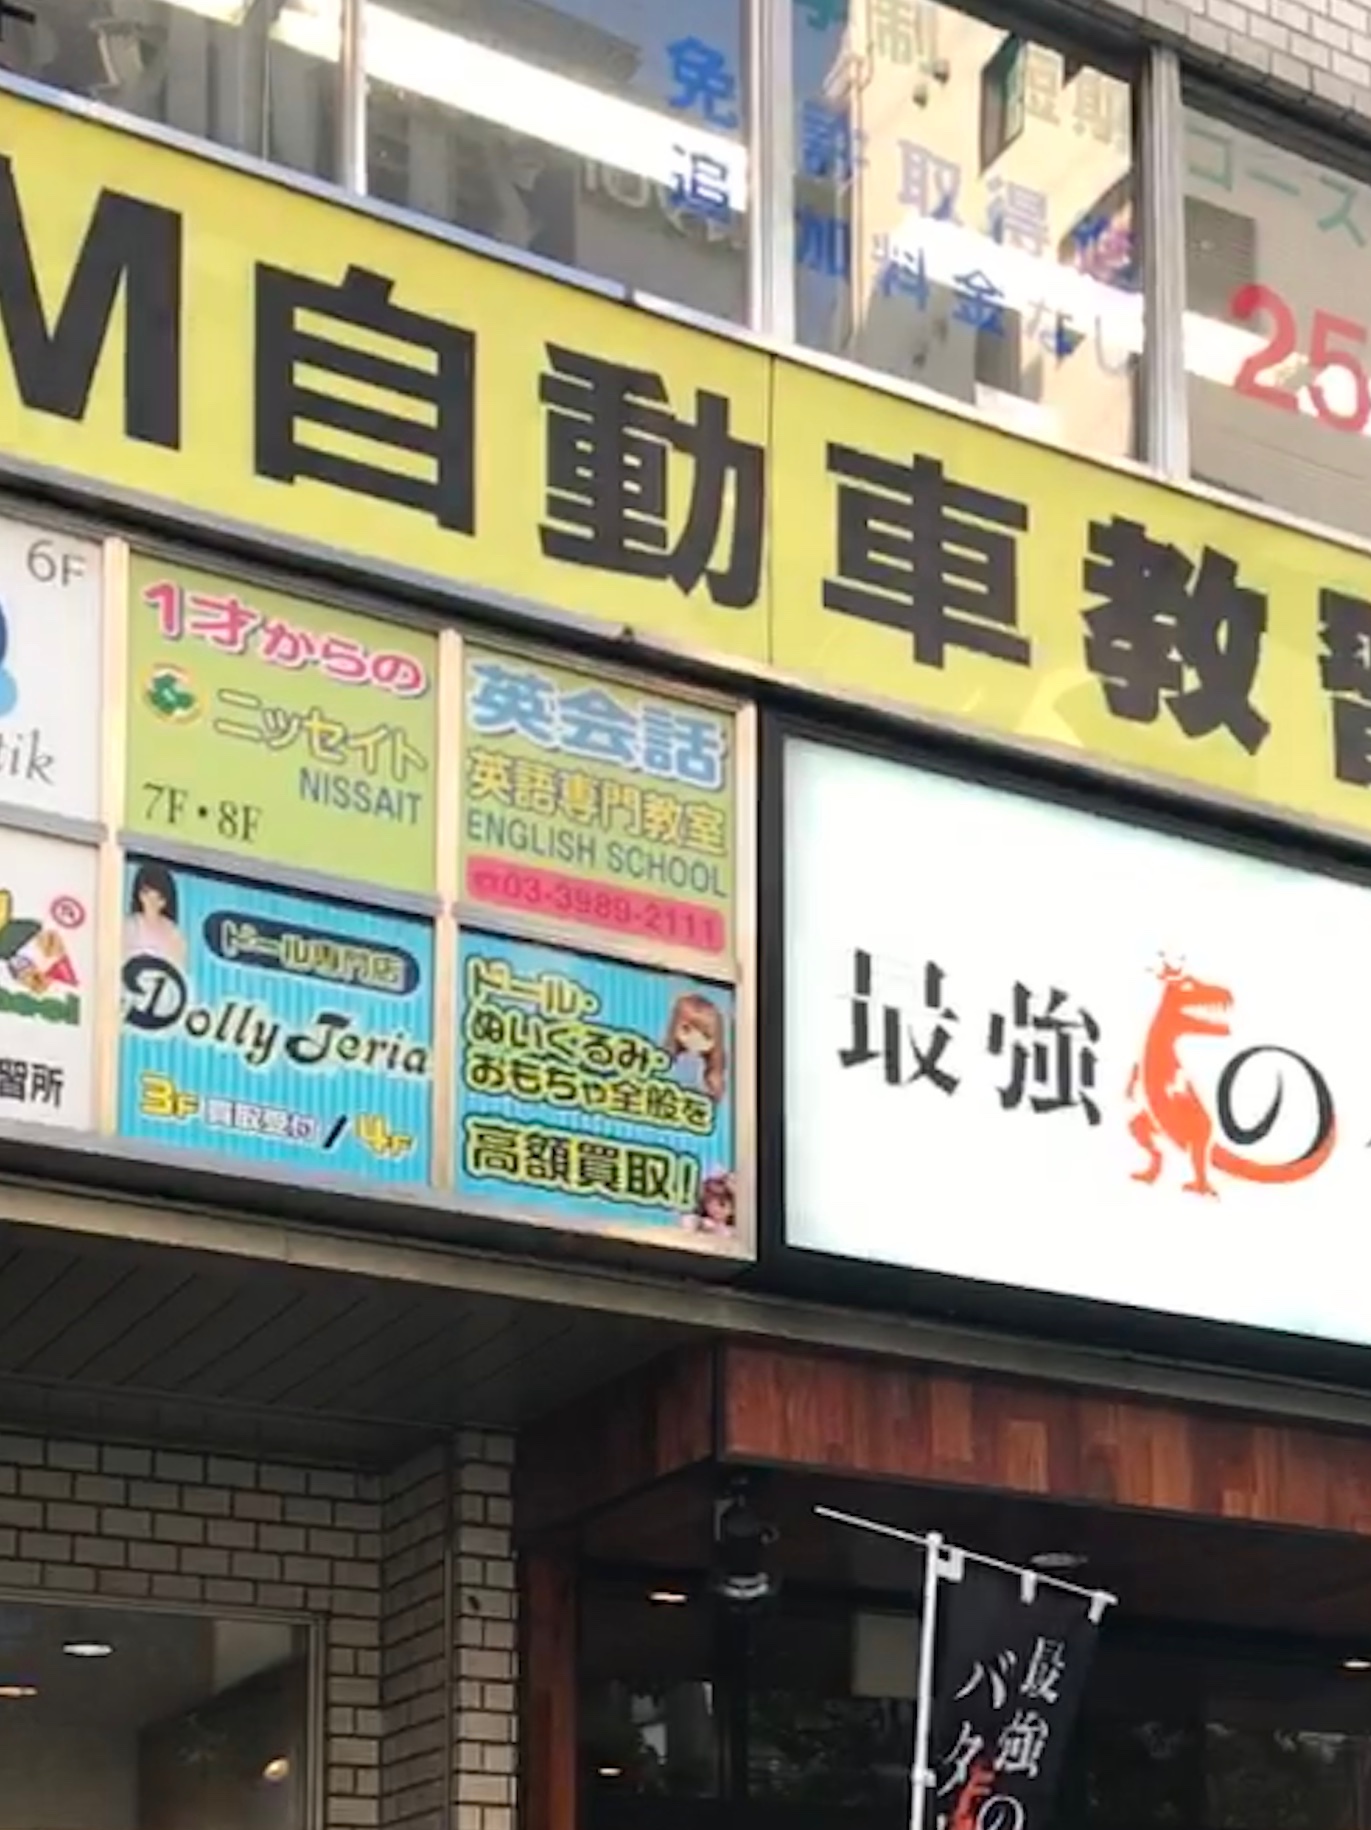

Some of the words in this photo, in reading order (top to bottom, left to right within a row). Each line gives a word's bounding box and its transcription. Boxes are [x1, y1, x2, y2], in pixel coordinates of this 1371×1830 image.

[26, 540, 85, 587] 6F
[143, 581, 424, 696] 1才からの
[213, 687, 428, 778] ニッセイト
[472, 662, 727, 790] 英会話
[299, 767, 422, 826] NISSAIT
[467, 810, 596, 869] ENGLISH
[606, 841, 727, 899] SCHOOL
[140, 1073, 198, 1118] 3F
[470, 1052, 710, 1127] おもちゃ全般を
